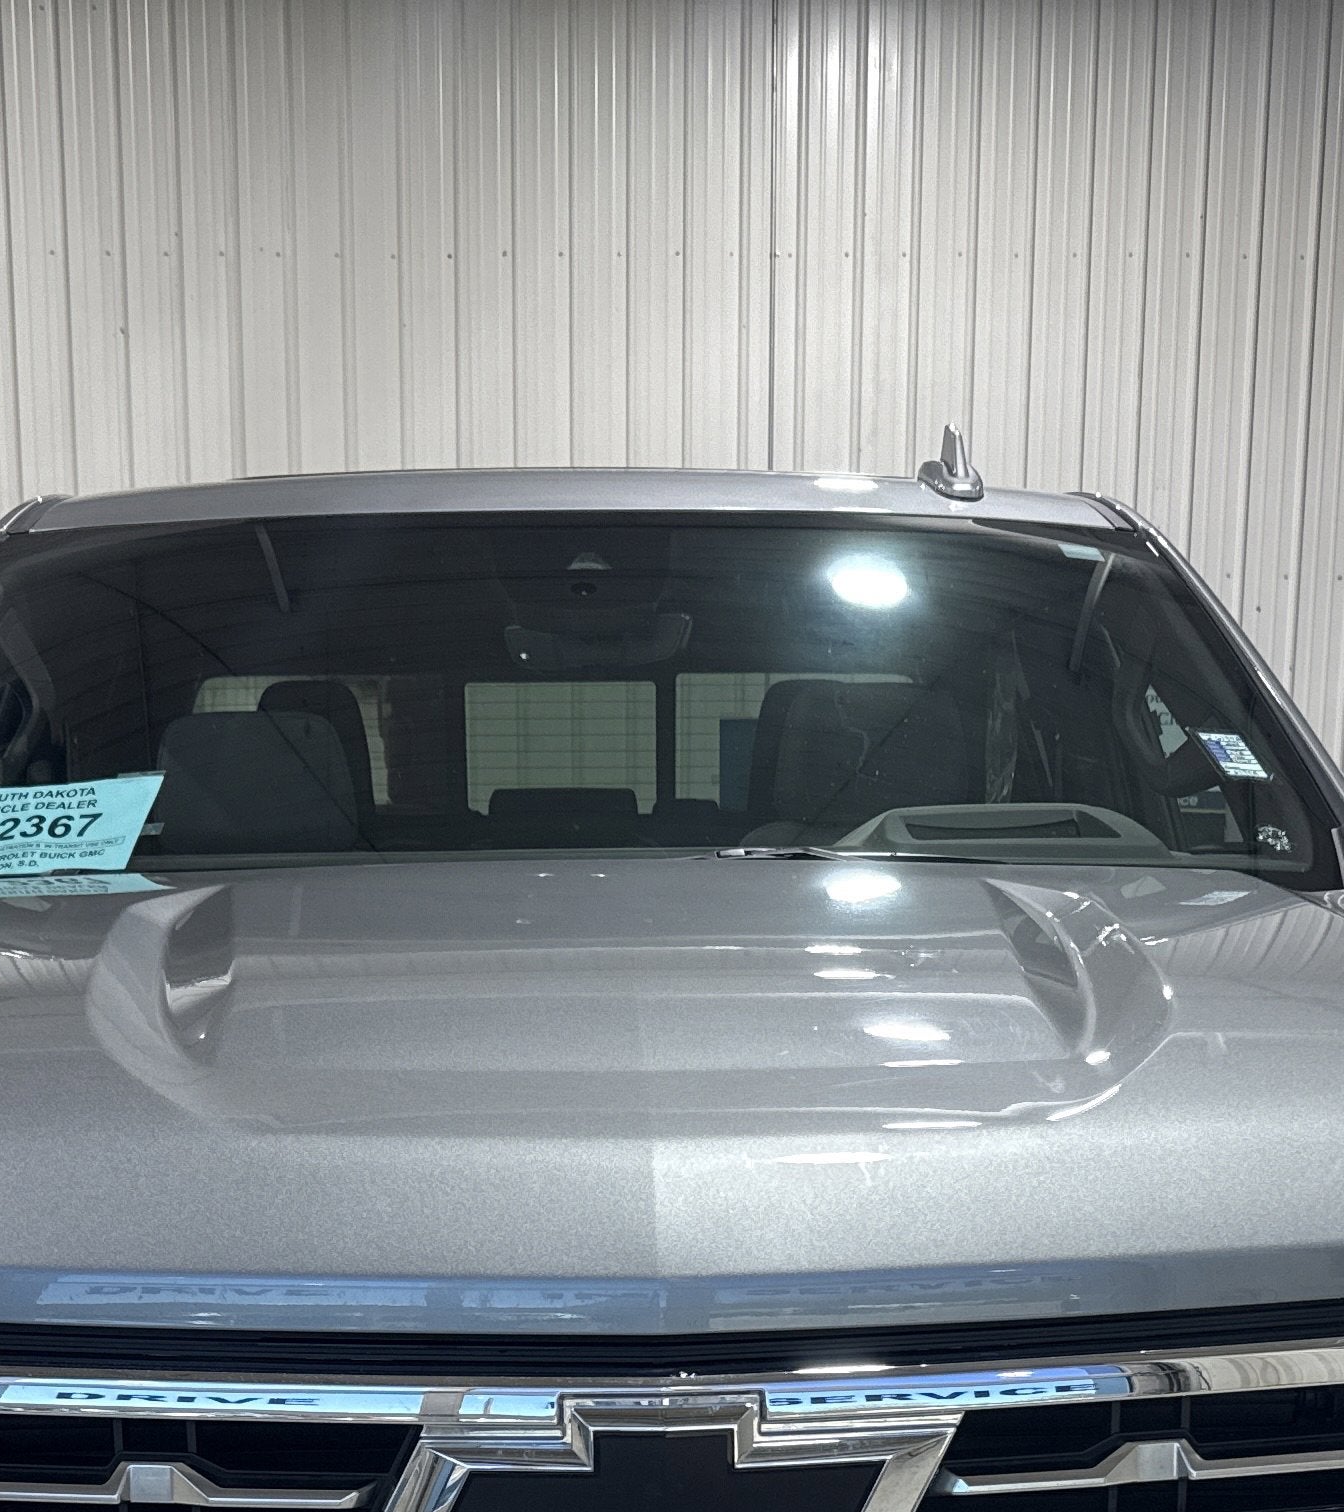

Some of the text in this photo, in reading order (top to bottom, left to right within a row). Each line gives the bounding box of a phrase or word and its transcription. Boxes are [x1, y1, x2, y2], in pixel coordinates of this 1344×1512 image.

[29, 787, 96, 800] DAKOTA
[35, 799, 97, 810] DEALER
[39, 851, 76, 859] BUICK
[79, 849, 106, 858] GMC
[55, 1383, 1097, 1407] DRIVE SERVICE
